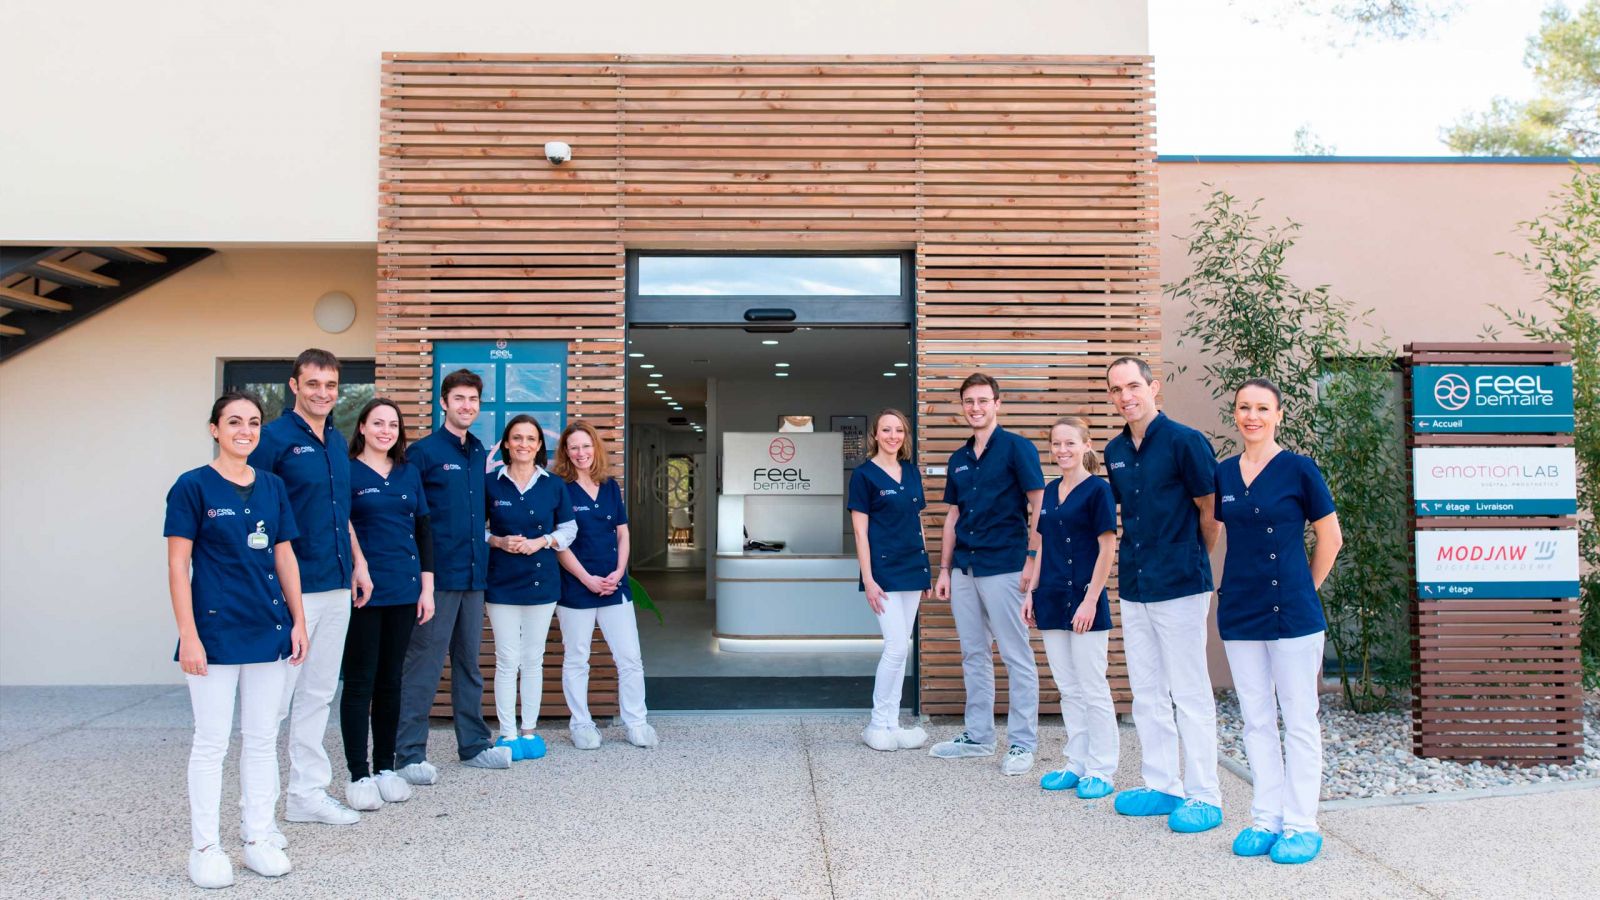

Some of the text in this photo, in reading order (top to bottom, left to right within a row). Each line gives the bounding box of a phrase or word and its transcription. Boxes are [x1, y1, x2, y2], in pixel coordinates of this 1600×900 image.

[1432, 419, 1463, 428] Accueil
[1523, 465, 1559, 478] LAB
[1445, 502, 1471, 513] étage
[1476, 502, 1514, 511] Livraison
[1448, 585, 1474, 595] étage
